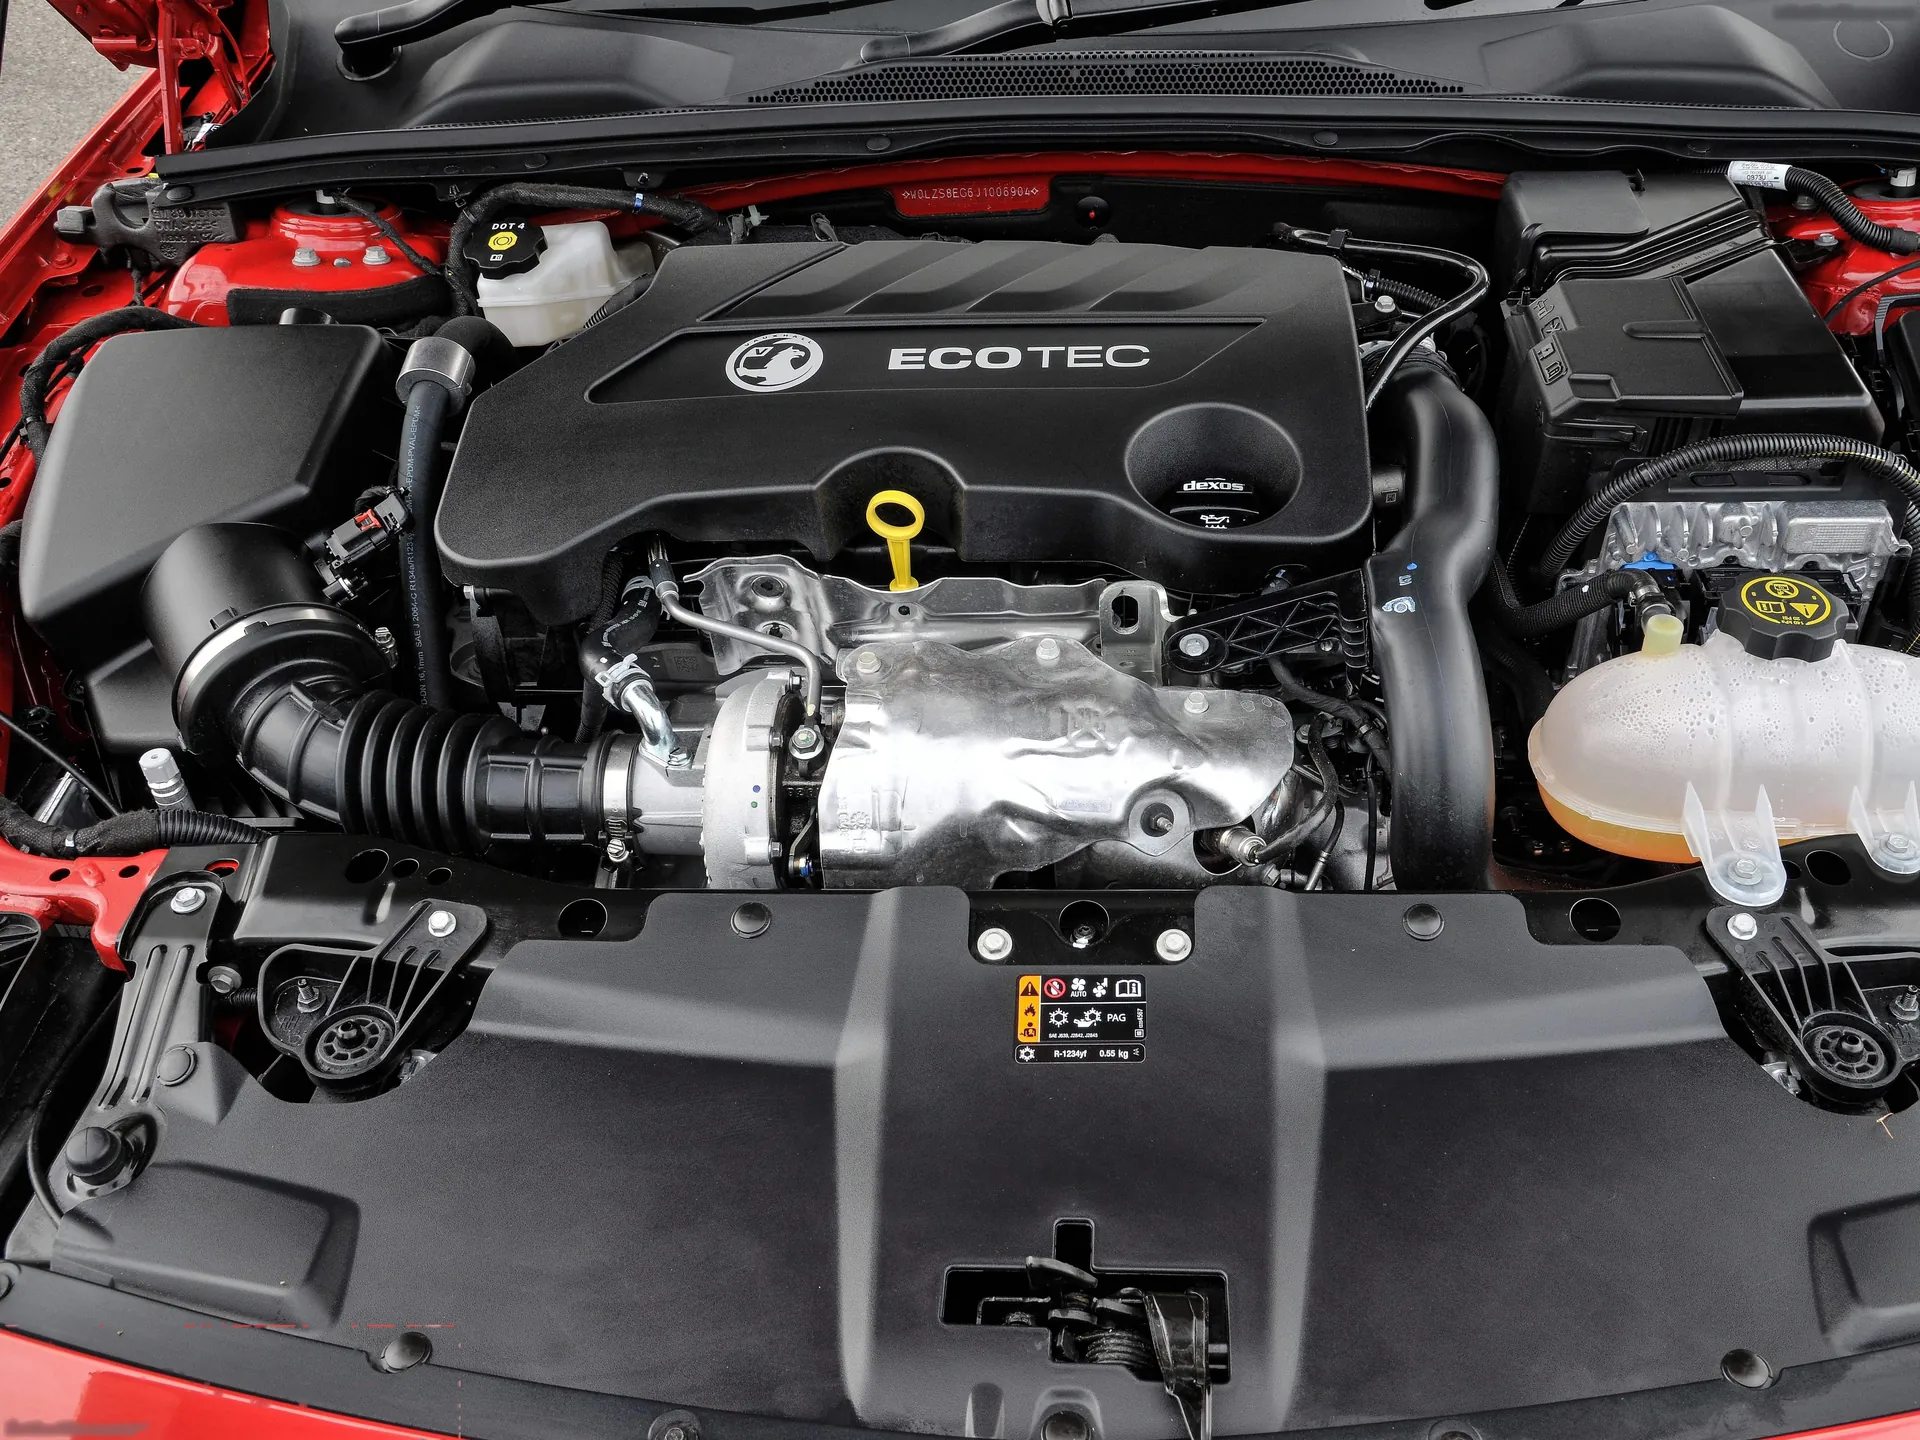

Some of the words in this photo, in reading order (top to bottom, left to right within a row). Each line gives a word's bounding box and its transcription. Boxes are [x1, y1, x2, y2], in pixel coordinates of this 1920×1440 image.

[491, 222, 516, 230] DOT
[517, 222, 526, 230] 4
[888, 344, 1150, 370] ECOTEC
[1183, 480, 1244, 491] dexos
[414, 630, 423, 647] SAE
[1107, 1013, 1126, 1022] PAG
[1053, 1049, 1087, 1059] R-1234yf
[1099, 1049, 1116, 1058] 0.55
[1118, 1049, 1129, 1060] kg
